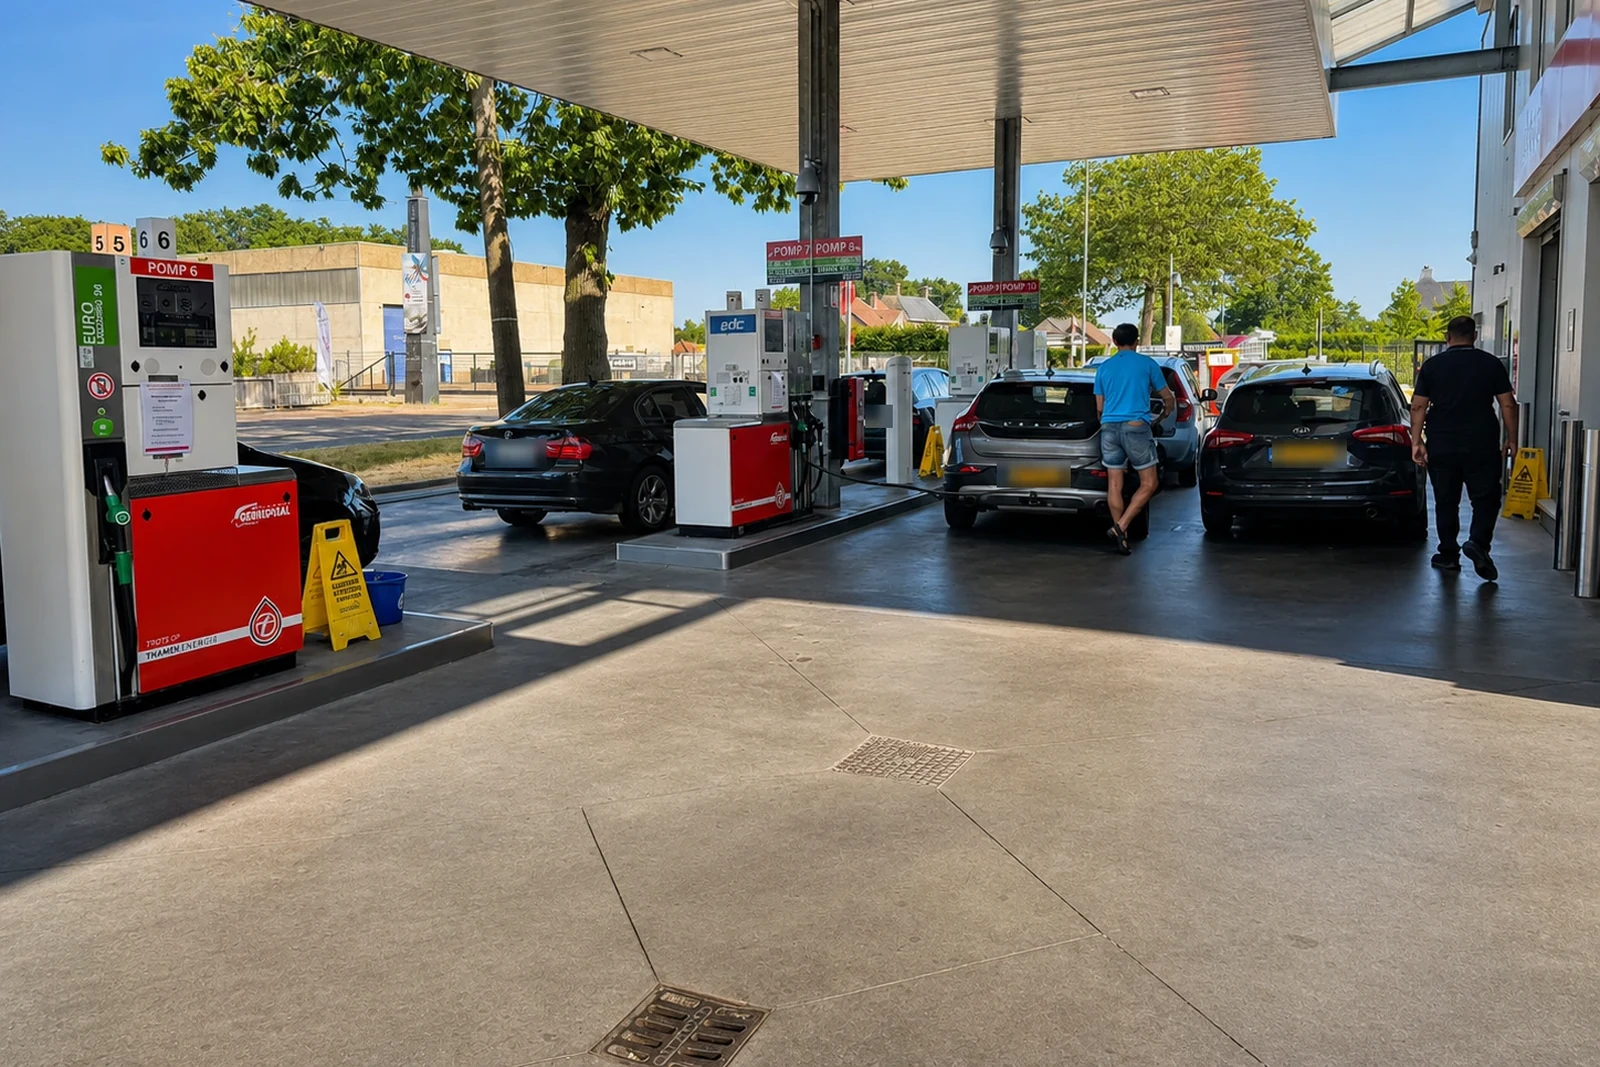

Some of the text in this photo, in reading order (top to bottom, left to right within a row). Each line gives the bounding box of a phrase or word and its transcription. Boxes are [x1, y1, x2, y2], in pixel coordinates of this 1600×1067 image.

[95, 235, 104, 251] 5
[113, 235, 125, 252] 5
[139, 230, 148, 249] 6
[157, 230, 170, 250] 6
[774, 245, 802, 257] POMP
[816, 242, 846, 254] POMP
[147, 261, 198, 277] POMP 6
[81, 302, 96, 345] EURO
[720, 317, 745, 332] edc
